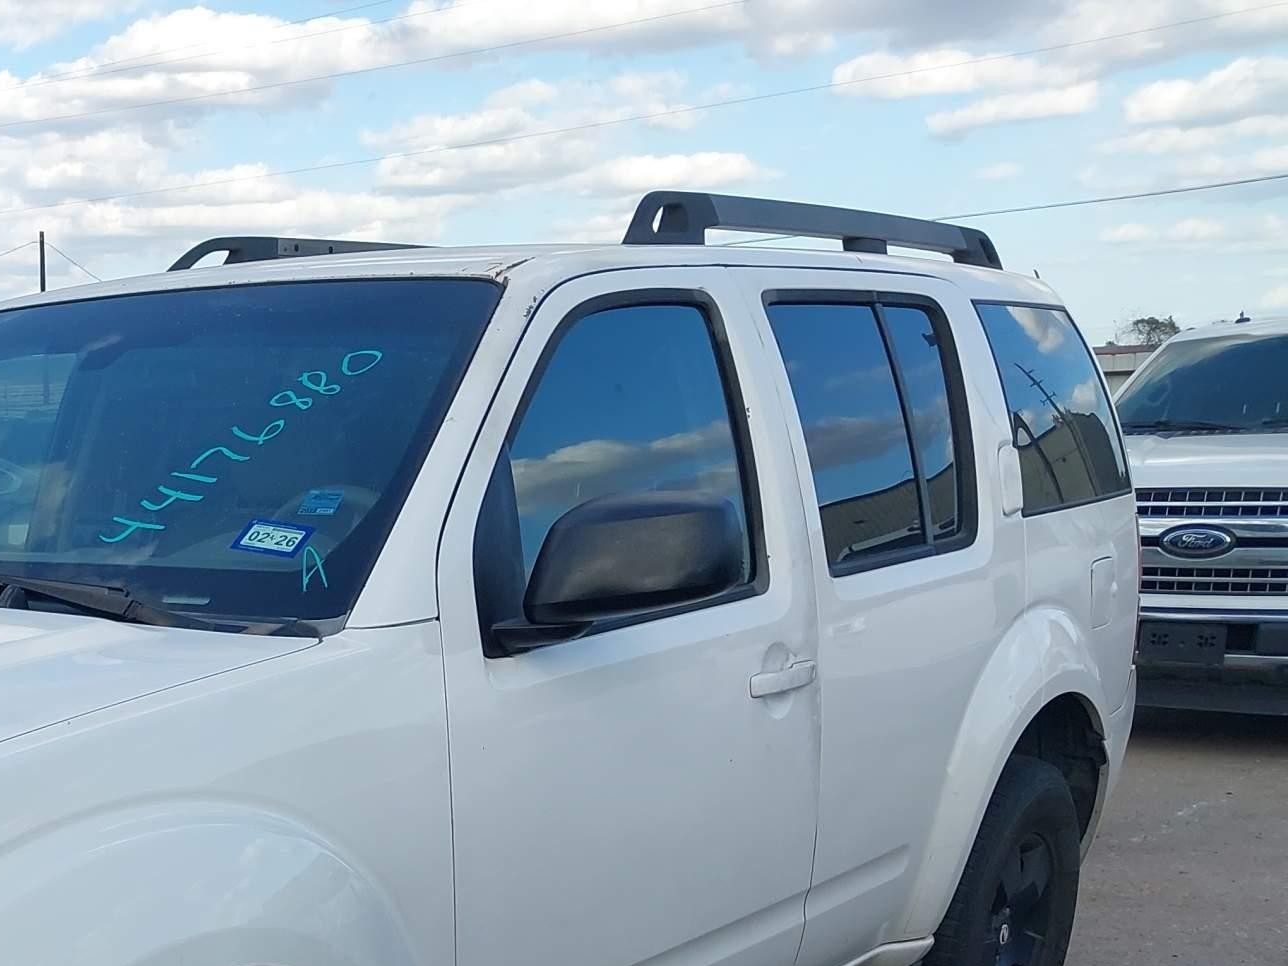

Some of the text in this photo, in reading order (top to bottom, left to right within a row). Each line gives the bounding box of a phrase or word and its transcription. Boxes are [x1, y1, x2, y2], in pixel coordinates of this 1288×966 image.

[98, 350, 383, 543] 44176880
[247, 530, 299, 548] 02 26
[1177, 533, 1215, 548] Ford
[301, 545, 328, 592] A
